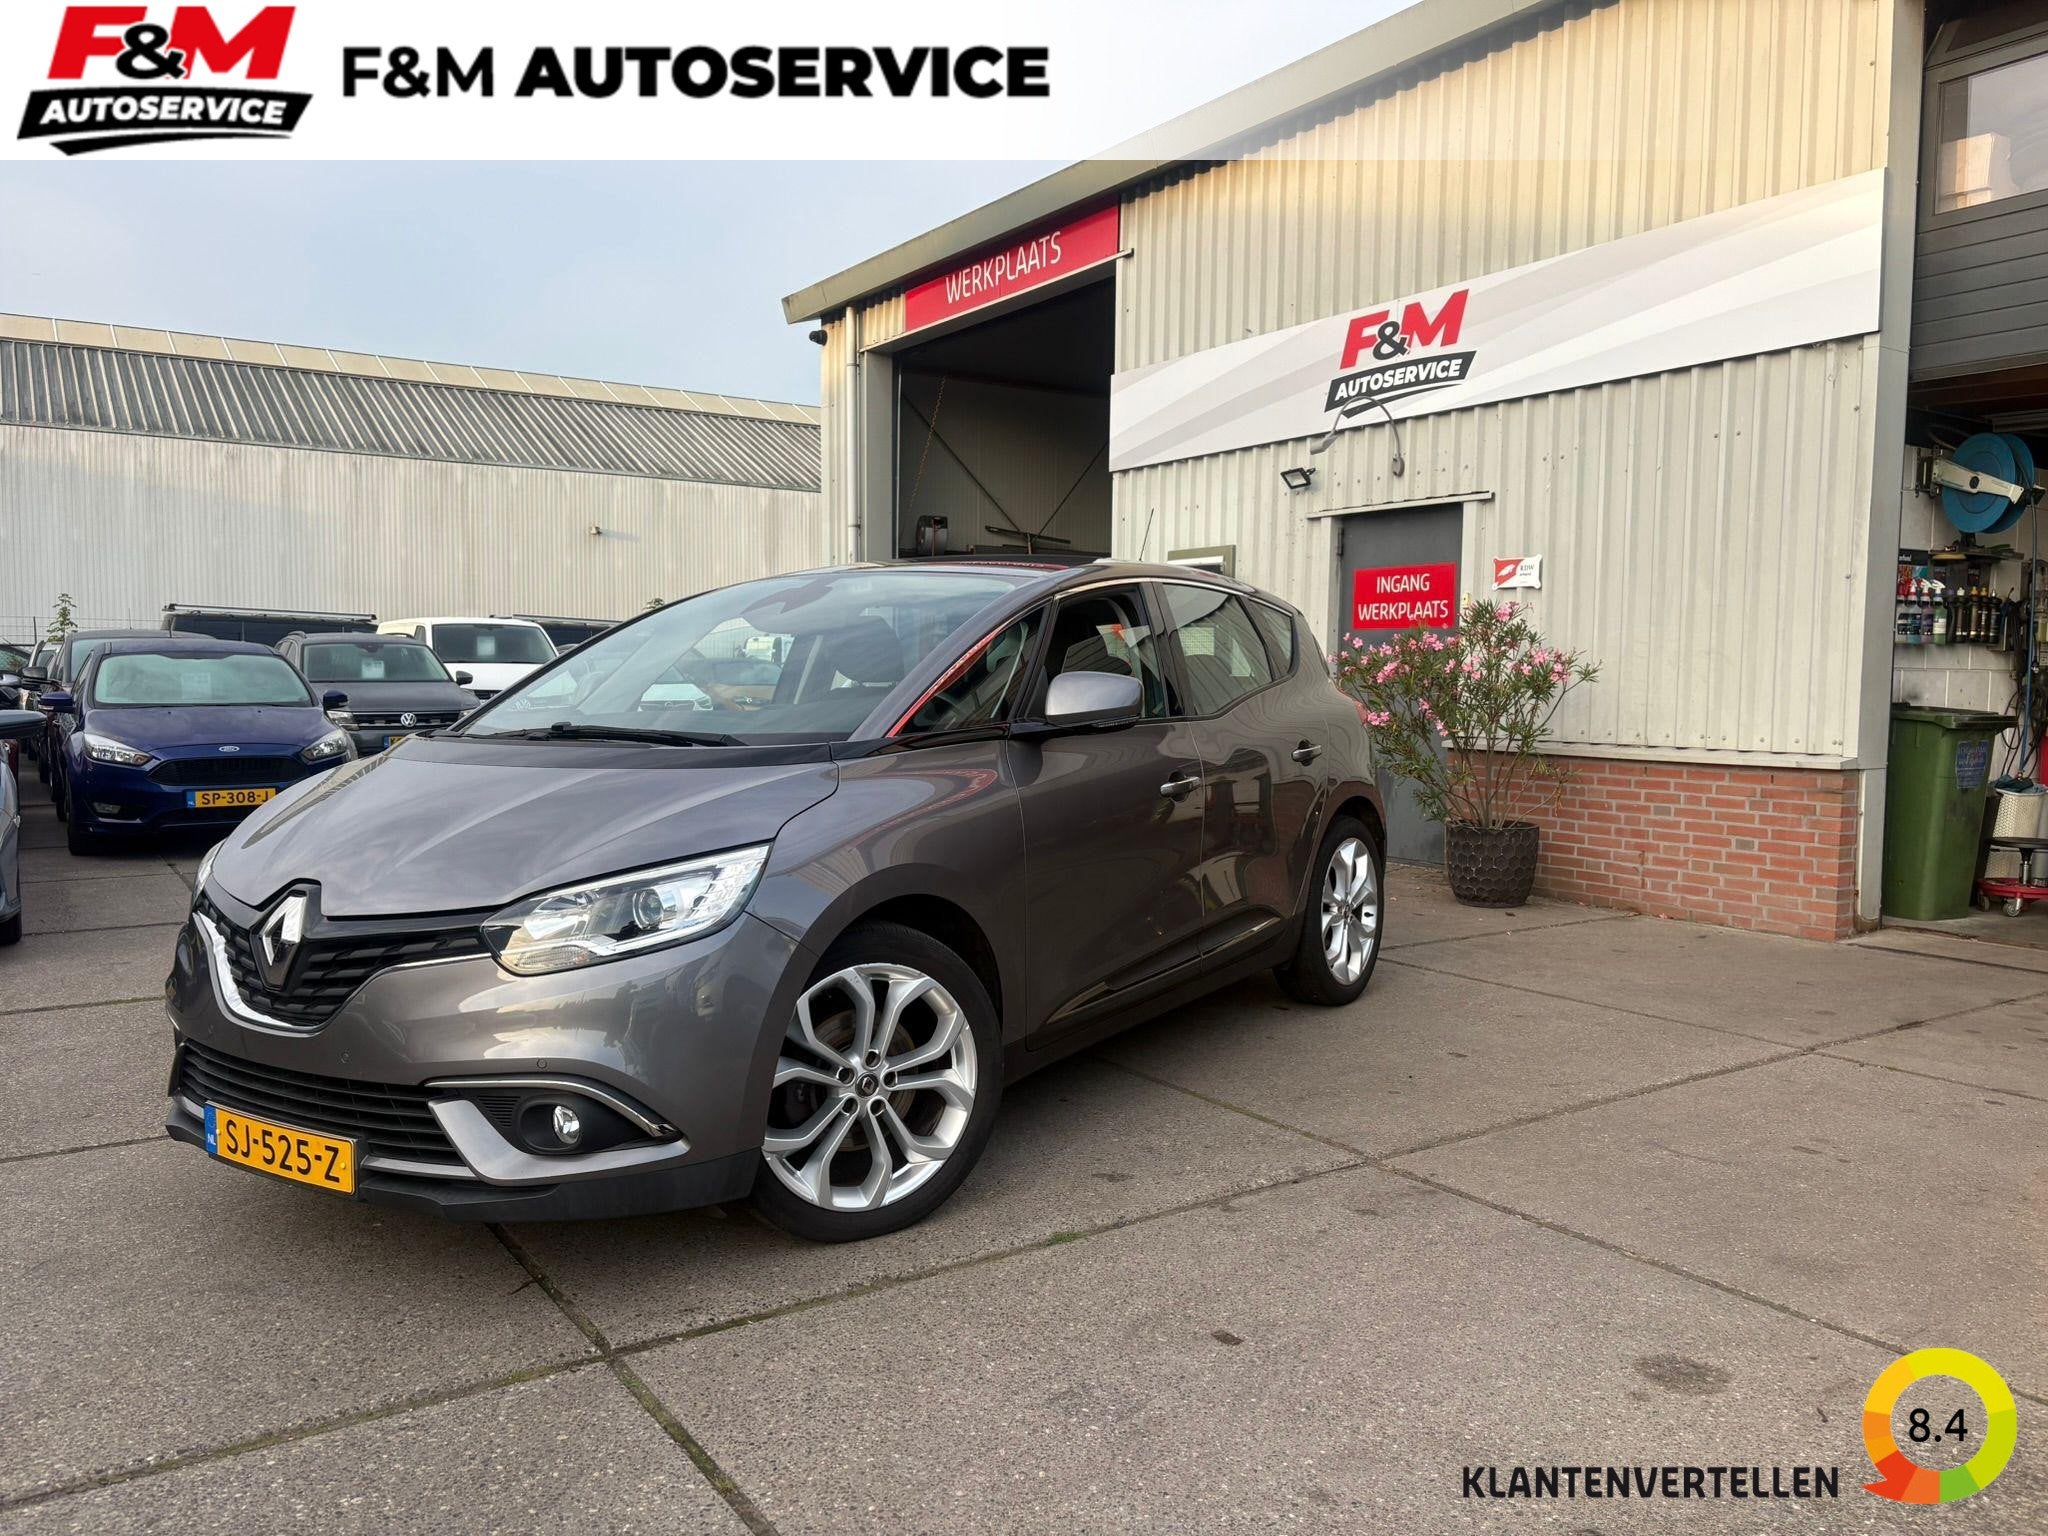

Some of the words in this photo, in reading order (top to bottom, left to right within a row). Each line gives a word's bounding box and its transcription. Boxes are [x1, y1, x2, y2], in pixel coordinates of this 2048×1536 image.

[945, 231, 1062, 304] WERKPLAATS
[1339, 288, 1469, 370] F&M
[1334, 358, 1463, 401] AUTOSERVICE
[1376, 573, 1430, 593] INGANG
[1358, 600, 1449, 621] WERKPLAATS
[201, 790, 269, 806] SP-308-J
[207, 1132, 217, 1146] NL
[225, 1119, 341, 1183] SJ-525-Z
